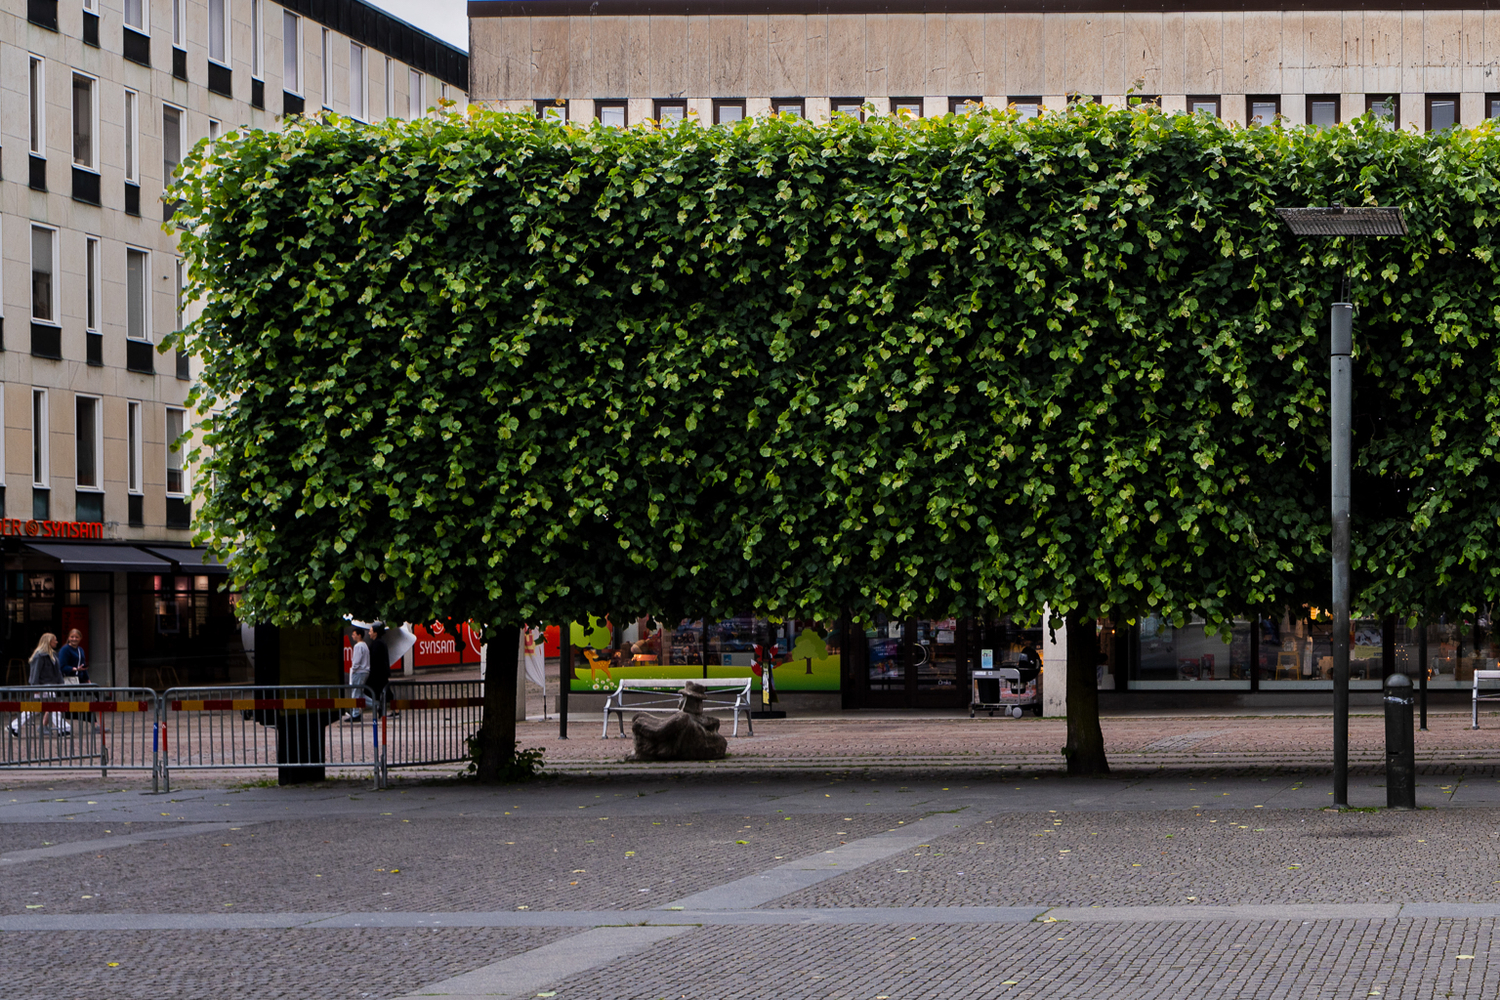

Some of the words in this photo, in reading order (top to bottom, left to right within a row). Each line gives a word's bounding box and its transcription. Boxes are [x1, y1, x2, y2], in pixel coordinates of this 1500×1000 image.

[0, 518, 22, 536] ER
[43, 520, 103, 539] SYNSAM
[419, 640, 456, 655] SYNSAM
